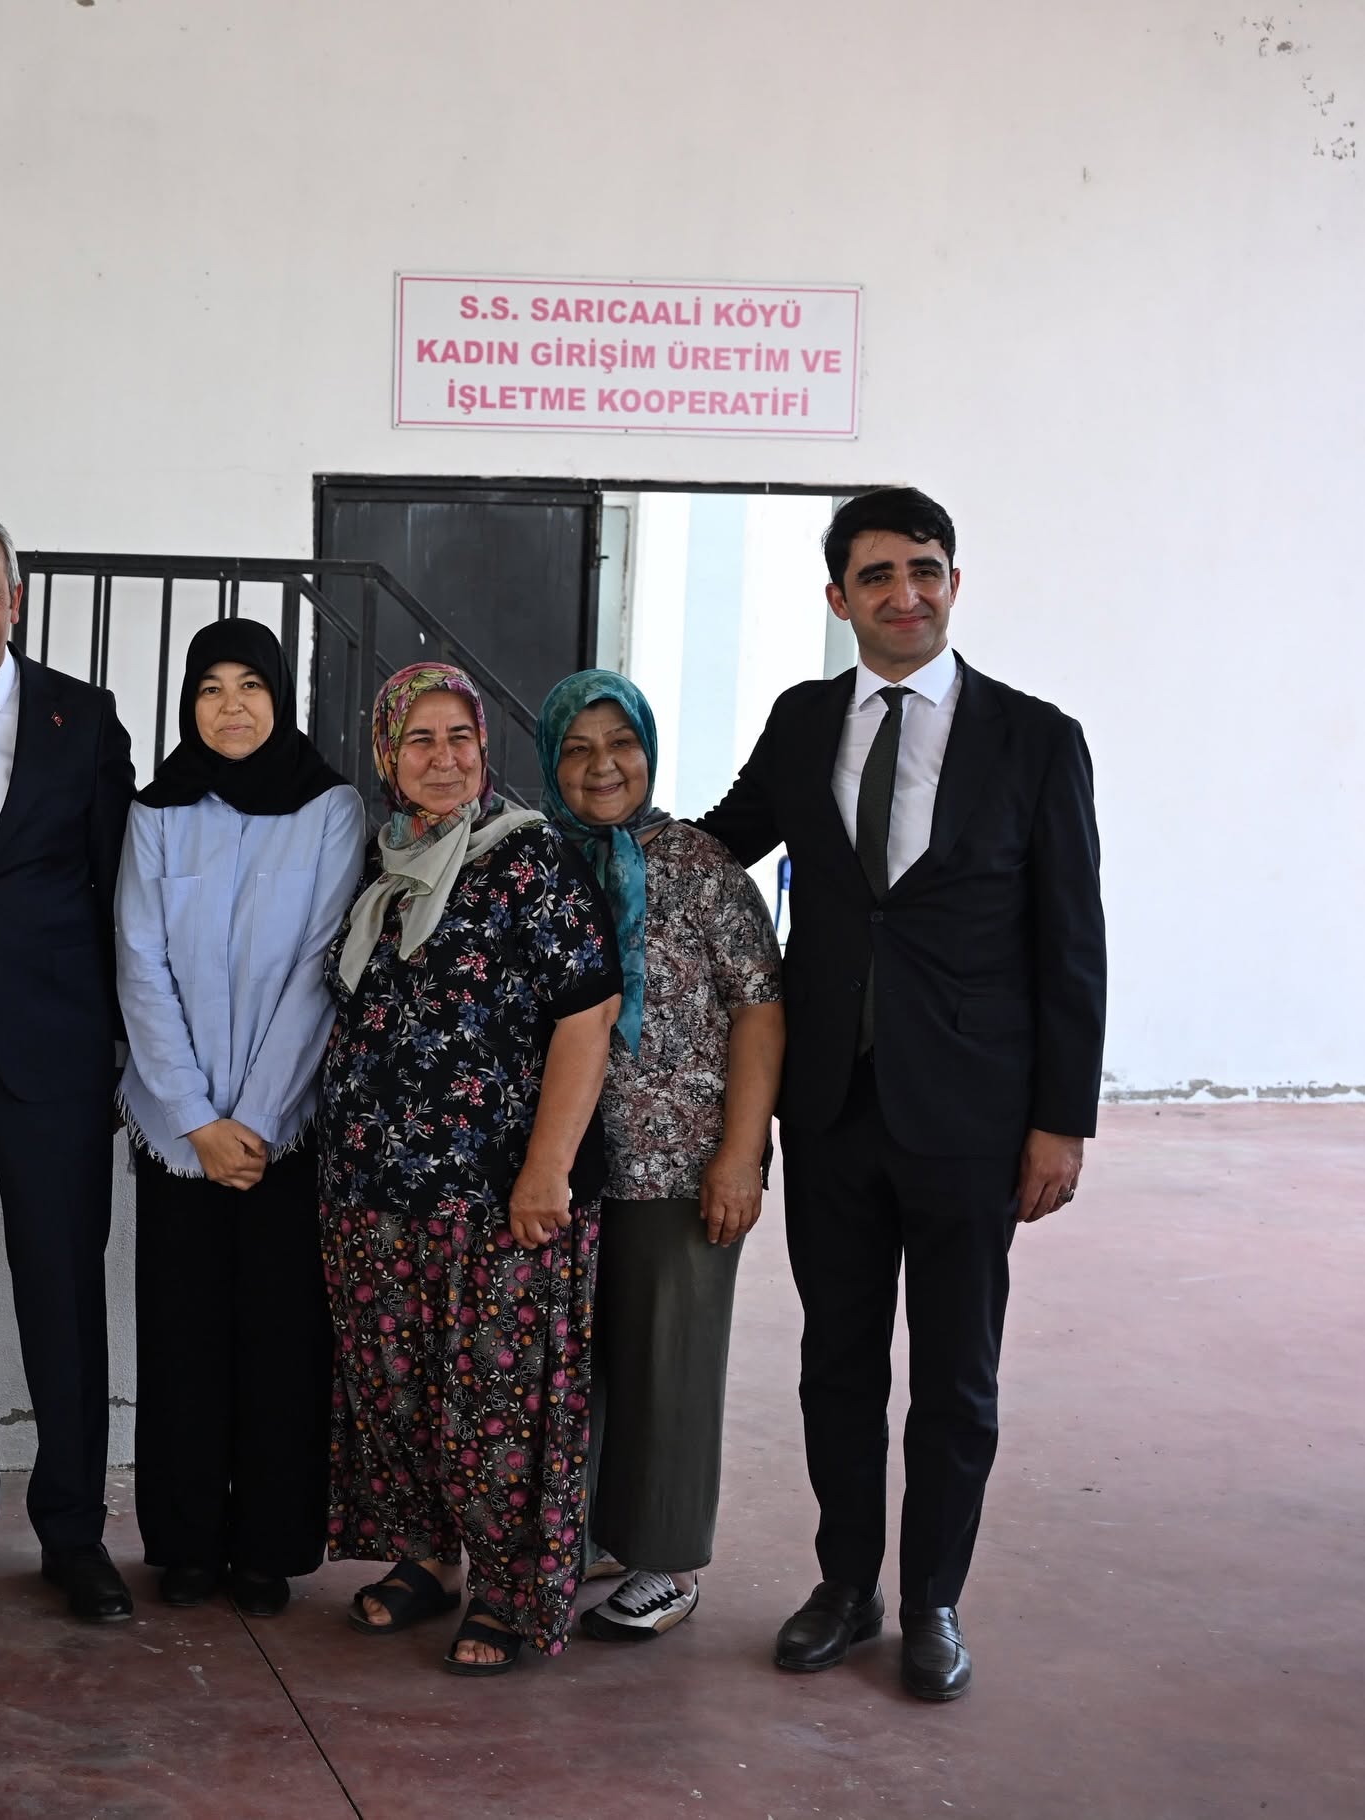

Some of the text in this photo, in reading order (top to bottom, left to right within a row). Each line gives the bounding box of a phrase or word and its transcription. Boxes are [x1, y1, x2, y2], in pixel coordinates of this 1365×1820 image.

[461, 295, 801, 328] S.S. SARICAALİ KÖYÜ
[417, 337, 841, 373] KADIN GİRİŞİM ÜRETİM VE
[448, 380, 809, 416] İŞLETME KOOPERATİFİ
